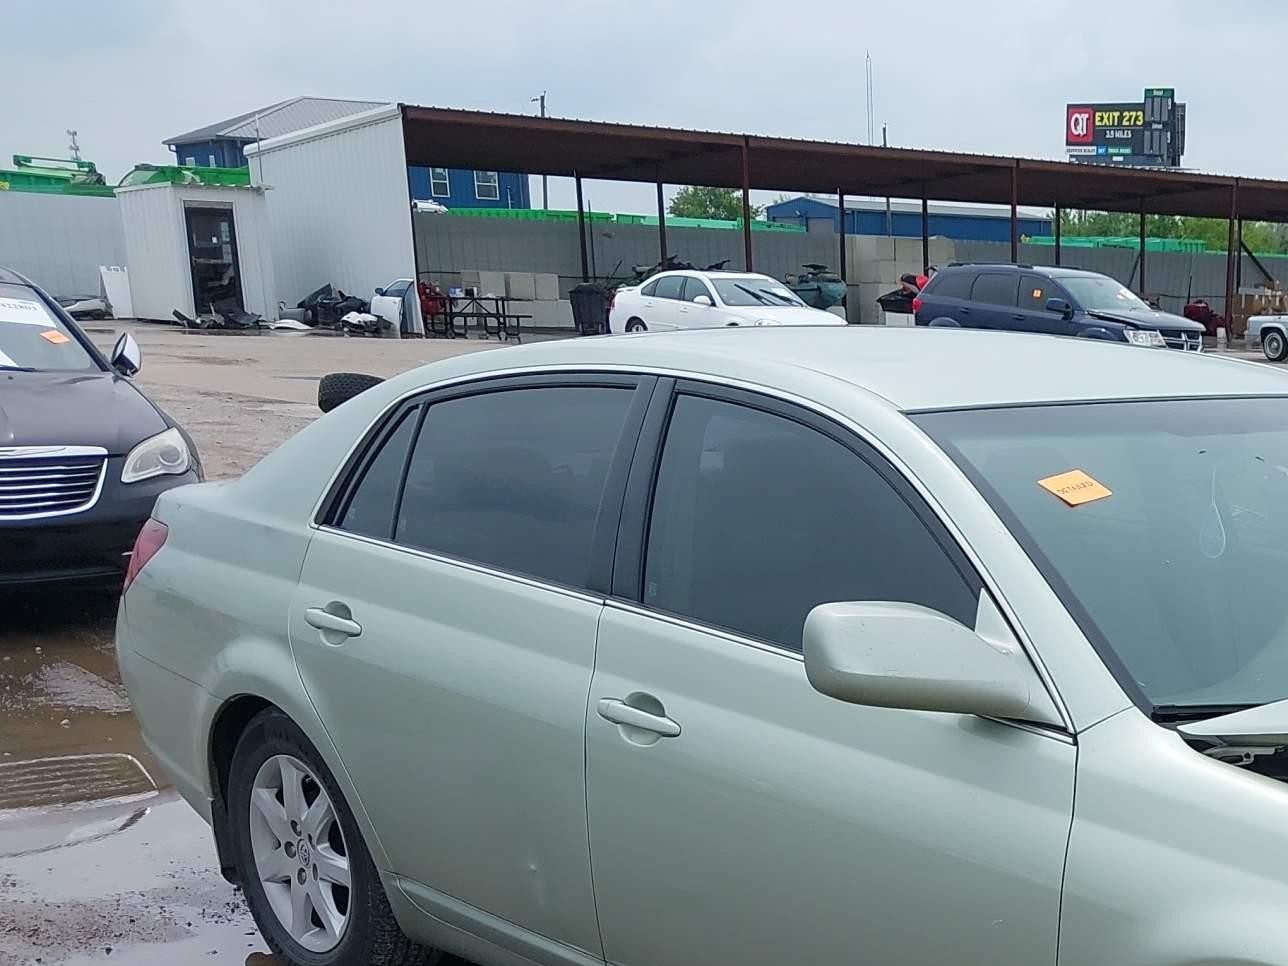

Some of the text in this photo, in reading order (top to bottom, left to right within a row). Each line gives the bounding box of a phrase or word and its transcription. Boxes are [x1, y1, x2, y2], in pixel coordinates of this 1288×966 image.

[1070, 112, 1089, 136] QT
[1095, 110, 1144, 126] EXIT 273
[1115, 130, 1132, 138] MILES
